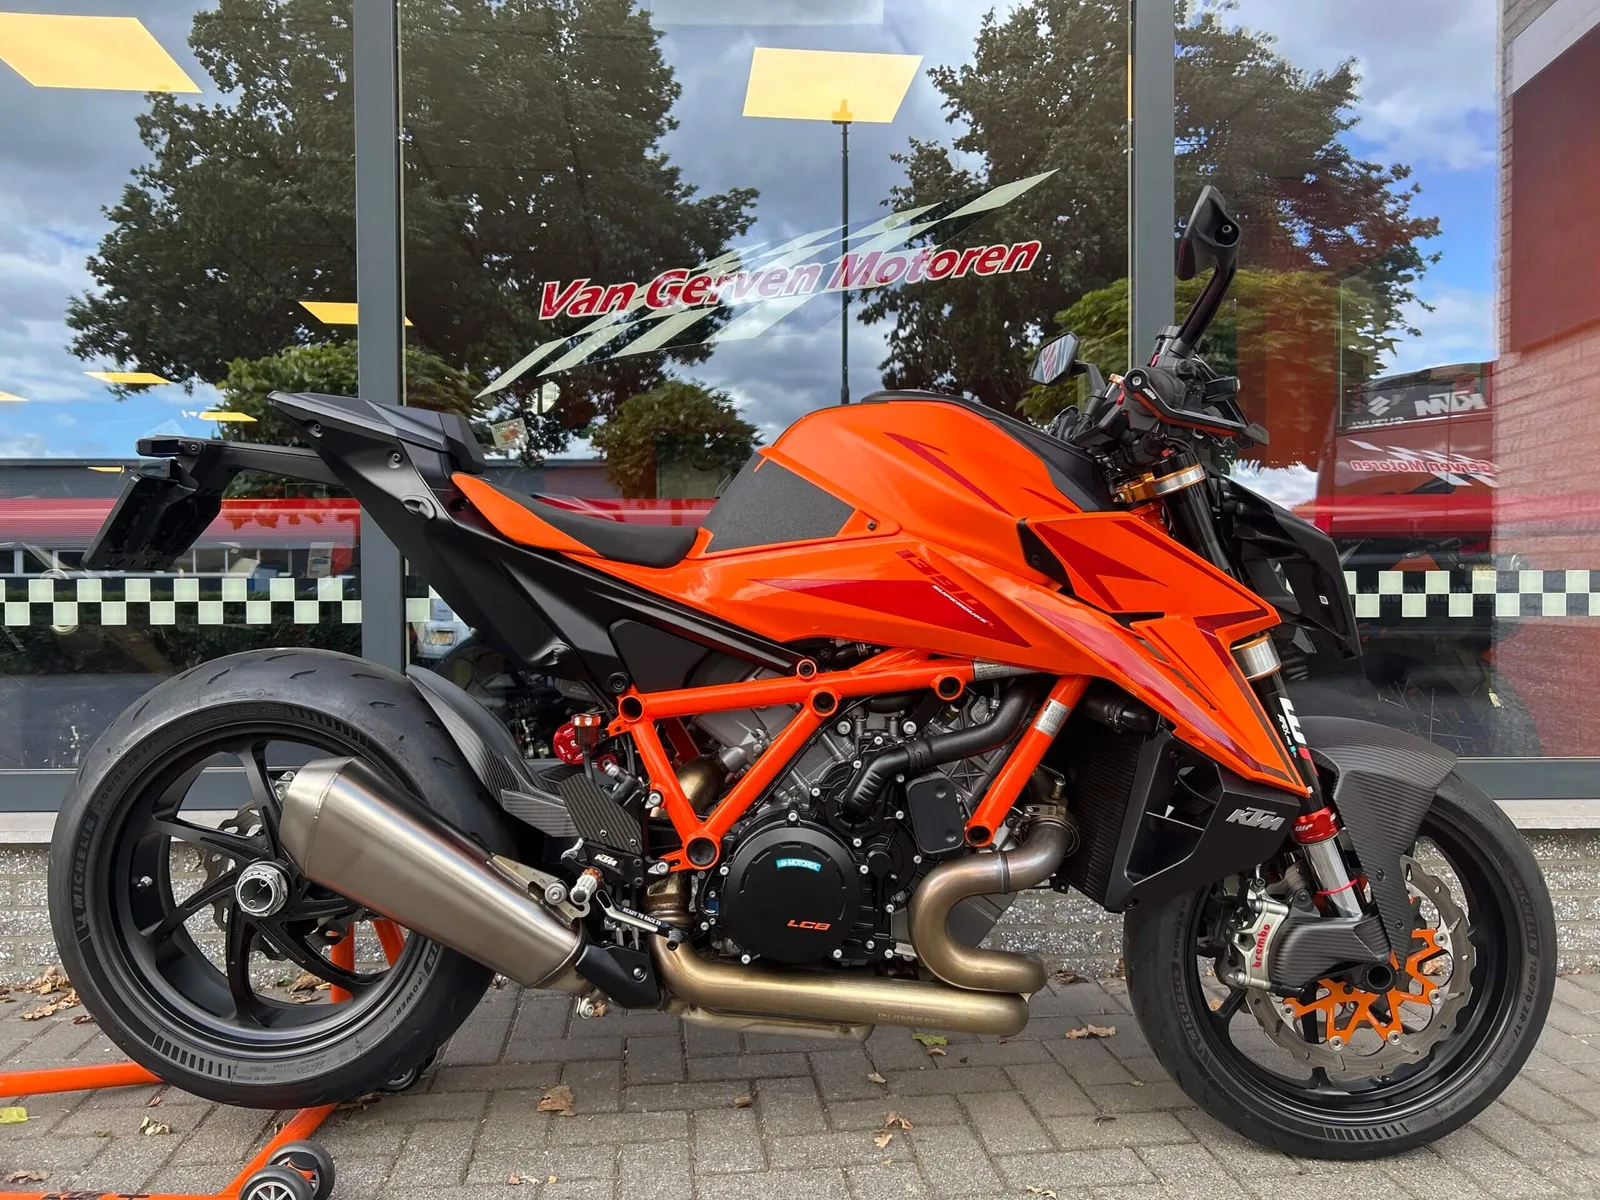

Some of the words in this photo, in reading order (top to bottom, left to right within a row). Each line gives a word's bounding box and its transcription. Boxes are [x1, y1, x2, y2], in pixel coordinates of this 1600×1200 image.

[537, 278, 637, 321] Van
[644, 262, 824, 310] Gerven
[827, 240, 1043, 290] Motoren
[1225, 806, 1286, 831] KTM
[73, 818, 97, 909] MICHELIN
[594, 853, 618, 867] KTM
[1252, 923, 1271, 969] brembo
[395, 974, 423, 1016] POWER
[1524, 959, 1538, 1003] 120/70
